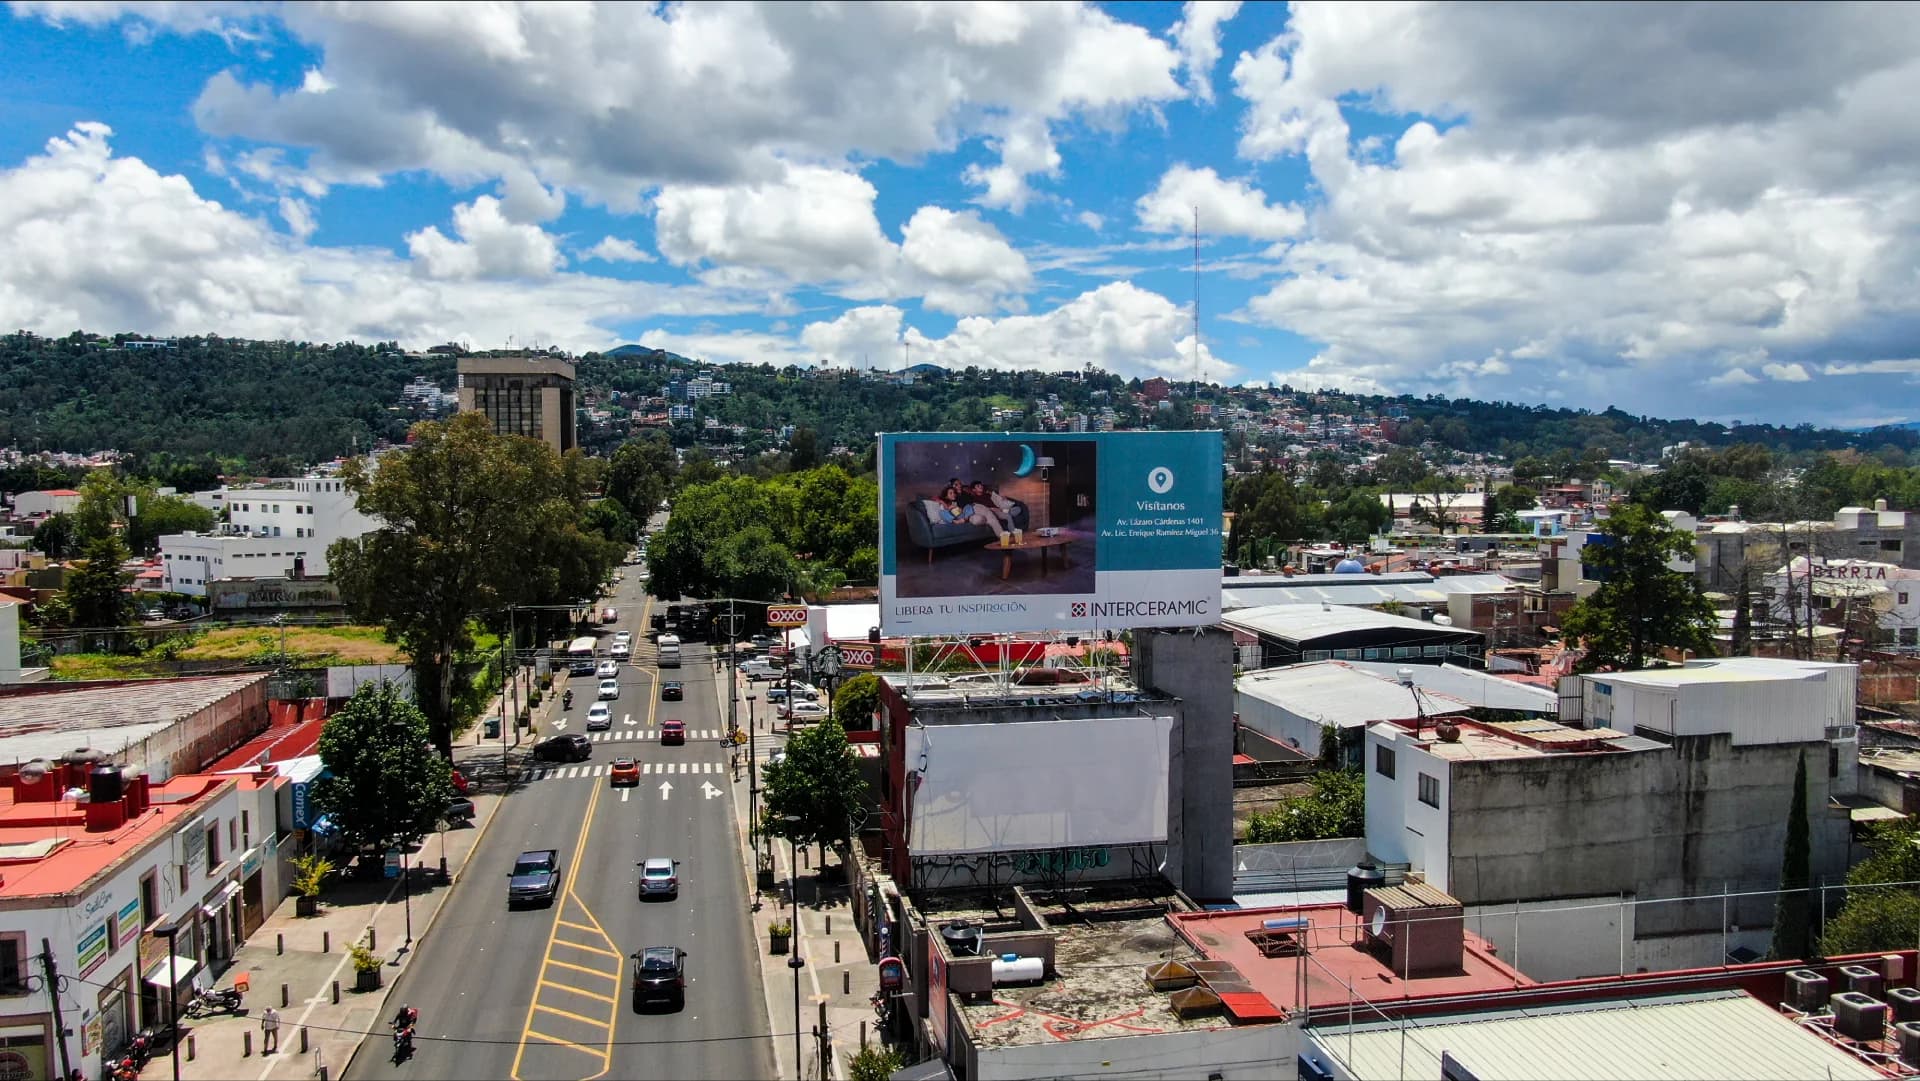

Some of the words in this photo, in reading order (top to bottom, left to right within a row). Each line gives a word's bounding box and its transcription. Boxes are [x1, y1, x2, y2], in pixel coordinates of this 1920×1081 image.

[1116, 518, 1128, 526] Av.
[1101, 529, 1114, 537] Av.
[1129, 529, 1155, 538] Enrique
[1185, 528, 1208, 538] Miguel
[1813, 565, 1886, 579] BIRRIA
[895, 605, 934, 616] LIBERA
[939, 604, 954, 614] TU
[1090, 600, 1208, 617] INTERCERAMIC
[769, 609, 806, 622] OXXO
[295, 783, 308, 826] Comex
